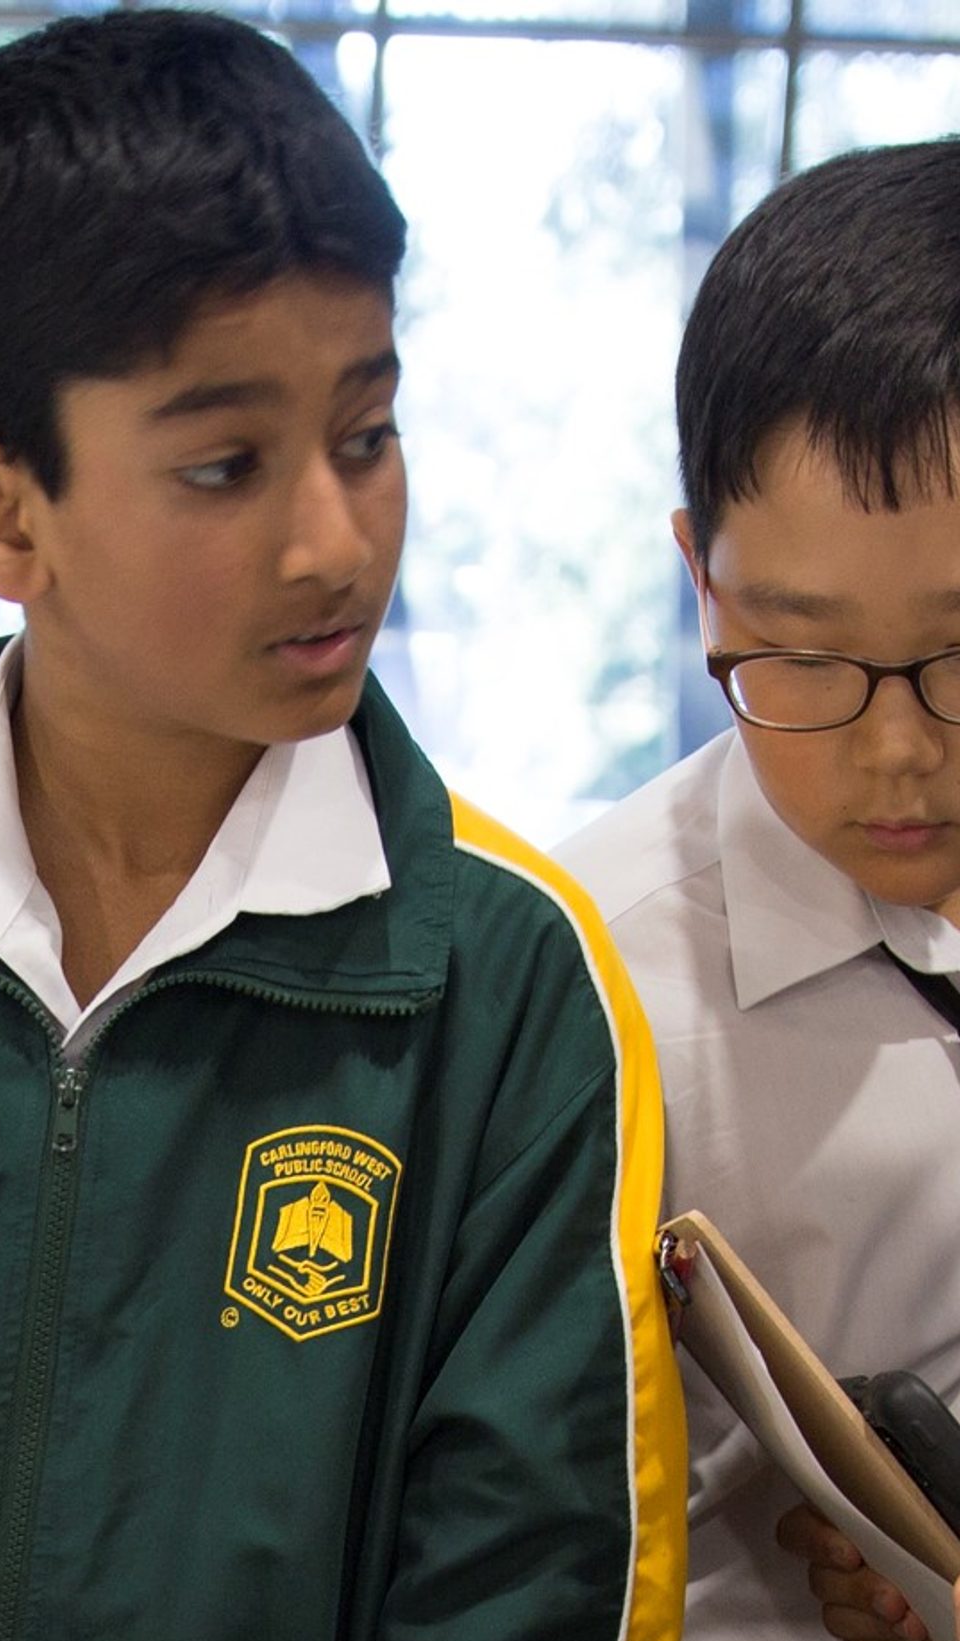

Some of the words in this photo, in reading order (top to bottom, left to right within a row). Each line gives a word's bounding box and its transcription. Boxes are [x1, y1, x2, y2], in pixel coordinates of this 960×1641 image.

[260, 1140, 352, 1167] CARLINGFORD
[351, 1150, 393, 1181] WEST
[274, 1158, 323, 1178] PUBLIC
[325, 1159, 374, 1191] SCHOOL
[242, 1277, 284, 1309] ONLY
[283, 1305, 321, 1326] OUR
[324, 1294, 369, 1319] BEST
